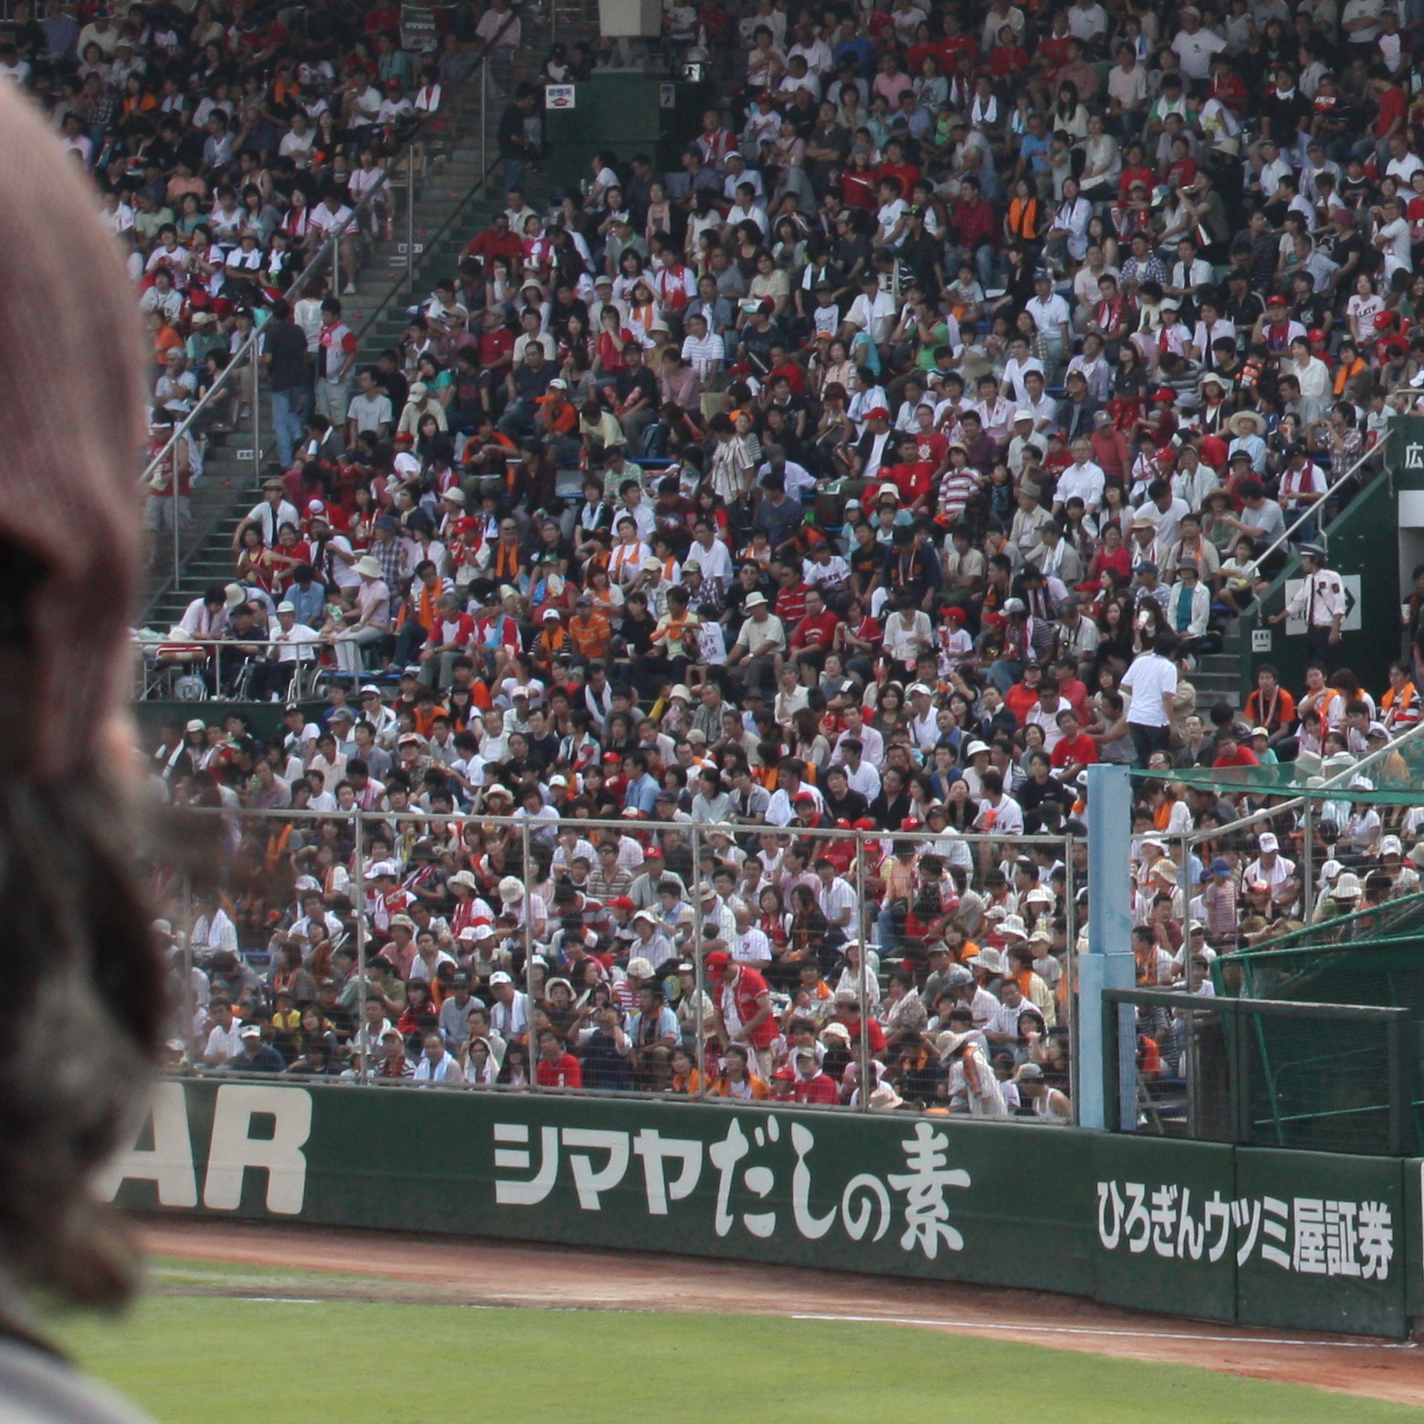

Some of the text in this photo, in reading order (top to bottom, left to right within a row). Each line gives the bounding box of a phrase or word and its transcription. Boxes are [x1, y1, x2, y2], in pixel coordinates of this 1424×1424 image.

[493, 1115, 971, 1260] シマヤだしの素
[1097, 1178, 1395, 1281] ひろぎんウツミ屋証券
